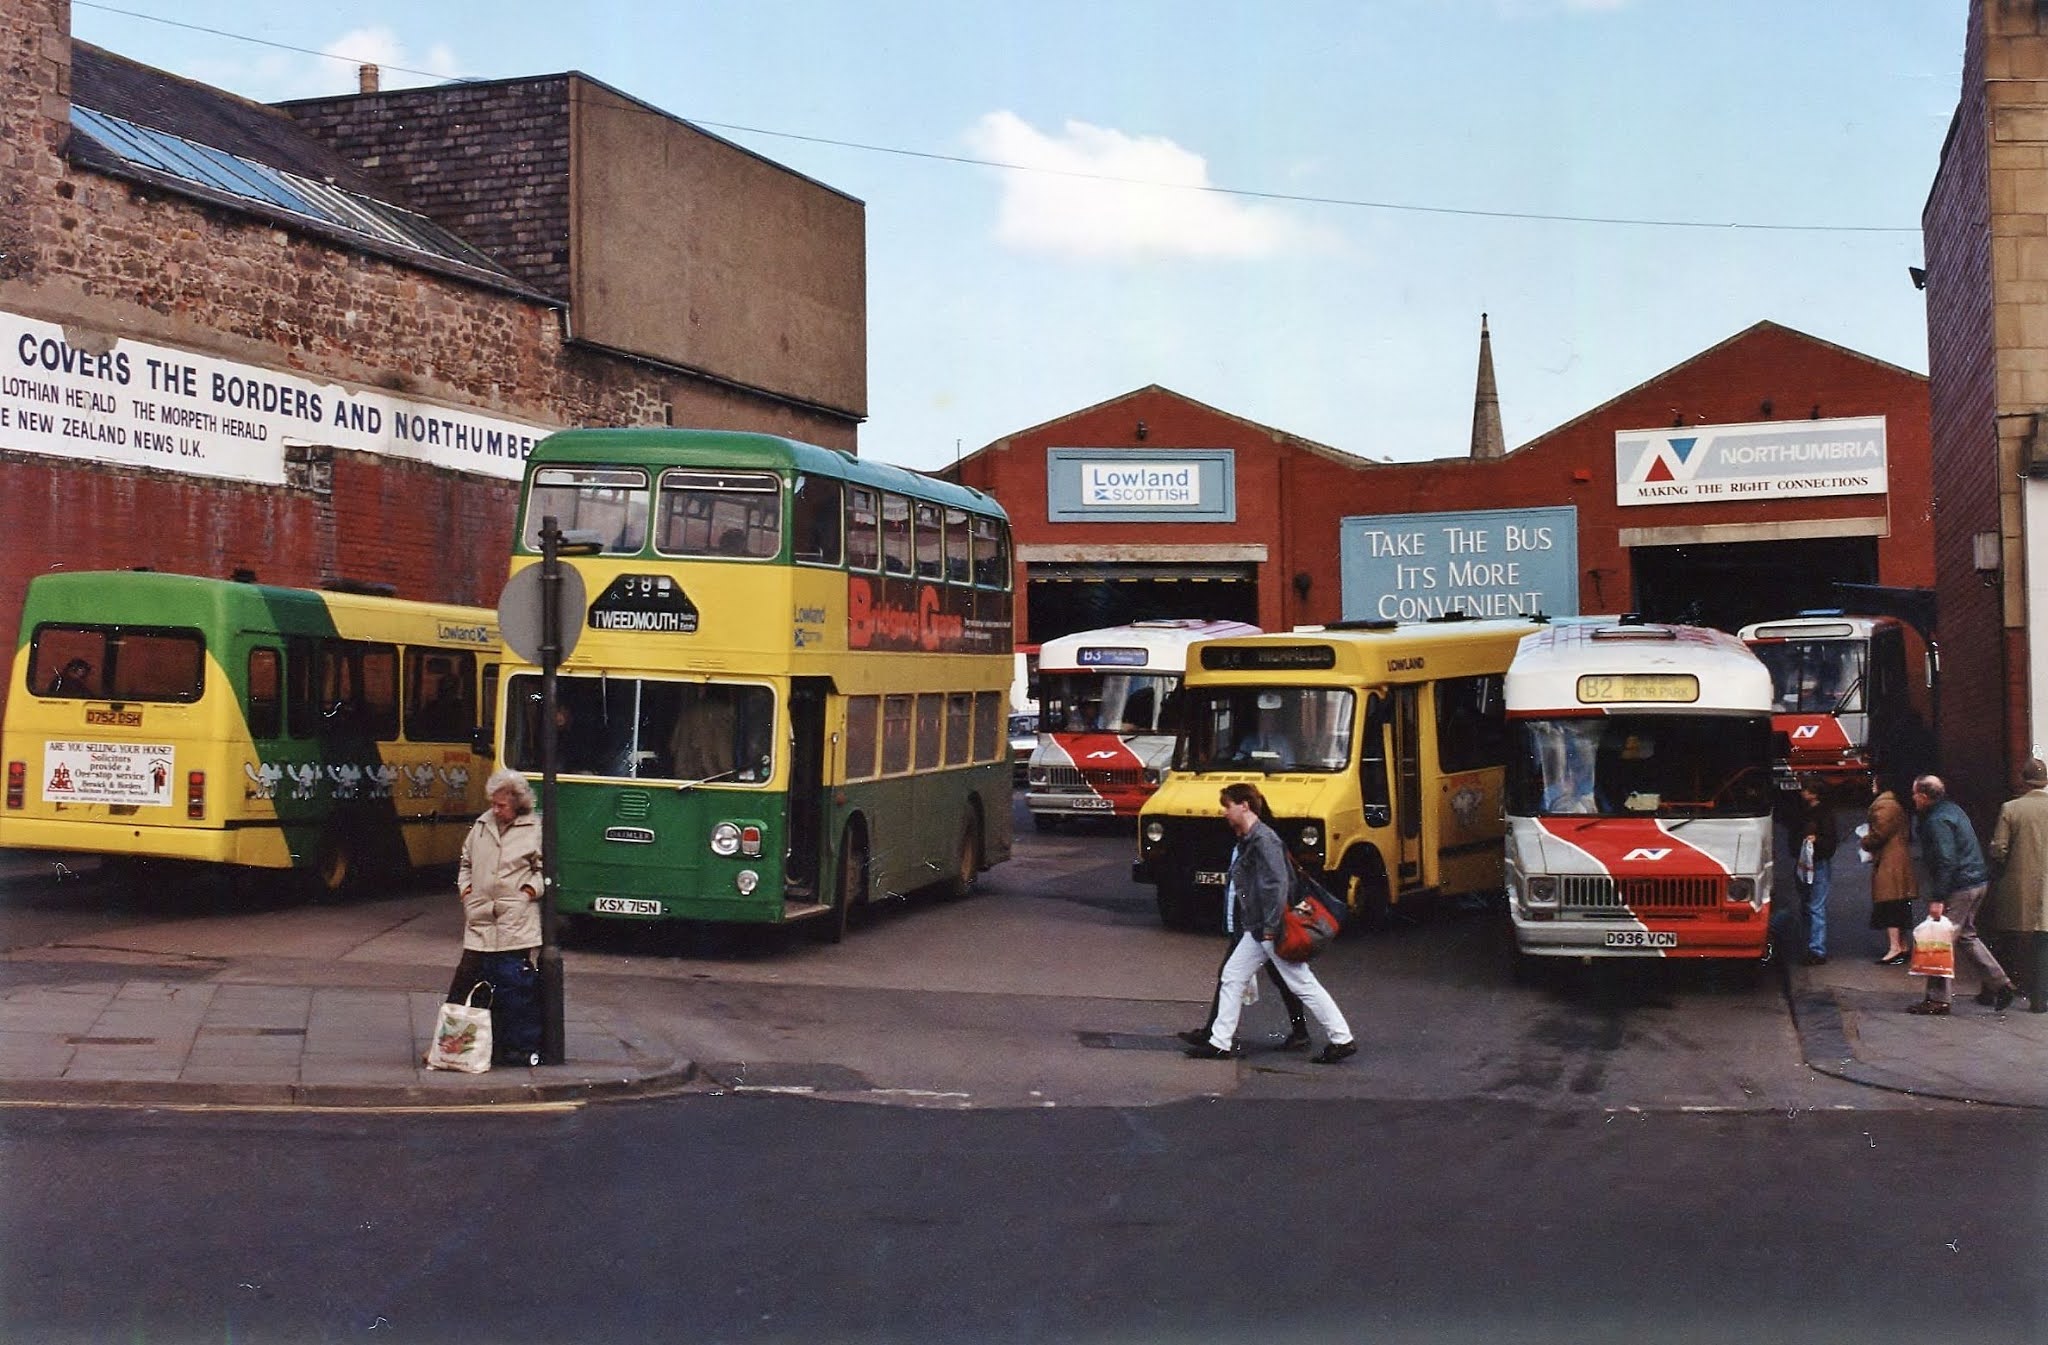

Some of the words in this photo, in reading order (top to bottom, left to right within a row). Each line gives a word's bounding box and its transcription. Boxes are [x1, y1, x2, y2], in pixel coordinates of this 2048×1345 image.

[18, 333, 131, 385] COVERS
[147, 359, 197, 397] THE
[213, 372, 323, 423] BORDERS
[334, 400, 382, 434] AND
[395, 411, 537, 461] NORTHUMBE
[2, 376, 59, 401] LOTHIAN
[133, 400, 155, 421] THE
[162, 406, 217, 432] MORPETH
[222, 420, 268, 441] HERALD
[18, 410, 54, 433] NEW
[63, 418, 126, 444] ZEALAND
[134, 430, 174, 454] NEWS
[180, 438, 206, 458] U.K.
[1720, 440, 1879, 464] NORTHUMBRIA
[1094, 469, 1188, 486] Lowland
[1637, 486, 1688, 497] MAKING
[1696, 483, 1722, 494] THE
[1730, 481, 1771, 492] RIGHT
[1777, 476, 1868, 490] CONNECTIONS
[1112, 489, 1189, 500] SCOTTISH
[1364, 531, 1425, 557] TAKE
[1443, 528, 1488, 554] THE
[1506, 525, 1552, 551] BUS
[1397, 564, 1436, 589] ITS
[1449, 561, 1520, 587] MORE
[1378, 593, 1543, 619] CONVENIENT
[594, 611, 678, 630] TWEEDMOUTH
[438, 625, 477, 640] Lowland
[1387, 657, 1424, 672] LOWLAND
[1585, 678, 1612, 698] B2
[1623, 687, 1656, 697] PRIOR
[1660, 687, 1688, 697] PARK
[87, 711, 116, 723] D752
[49, 742, 65, 751] ARE
[68, 743, 83, 752] YOU
[86, 744, 117, 753] SELLING
[120, 745, 140, 753] YOUR
[143, 746, 172, 755] HOUSE?
[91, 753, 131, 763] Solicitors
[90, 762, 122, 771] provide
[116, 773, 145, 781] service
[609, 830, 650, 840] DAIMLER
[599, 899, 625, 911] KSX
[628, 901, 657, 913] 715N
[1607, 932, 1644, 945] D936
[1647, 933, 1675, 945] VCN
